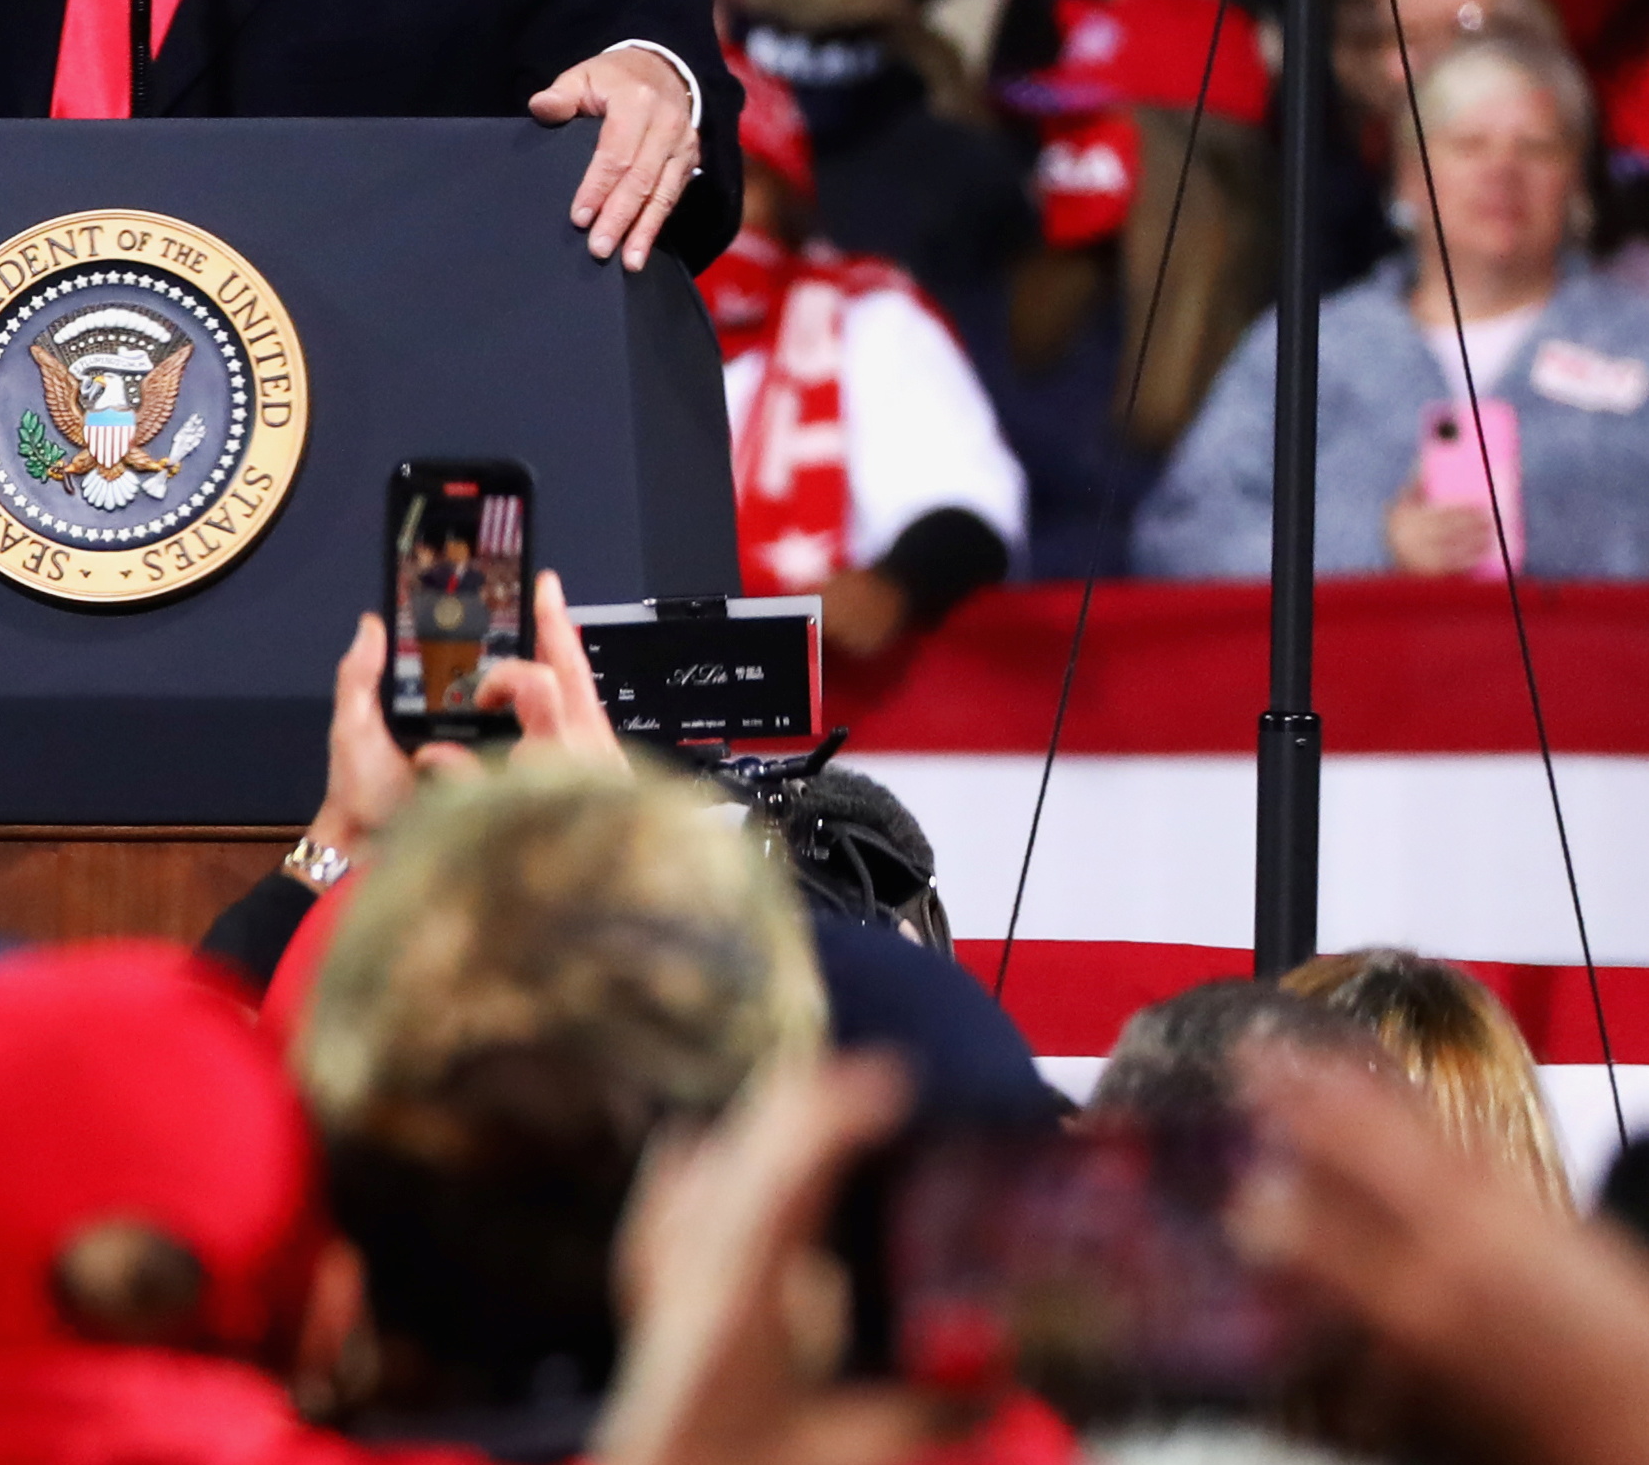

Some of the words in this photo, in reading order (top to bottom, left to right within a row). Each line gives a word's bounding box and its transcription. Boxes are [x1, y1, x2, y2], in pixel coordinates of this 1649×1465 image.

[116, 228, 153, 252] OF
[159, 235, 209, 275] THE
[215, 269, 294, 430] UNITED
[140, 464, 275, 584] STATES
